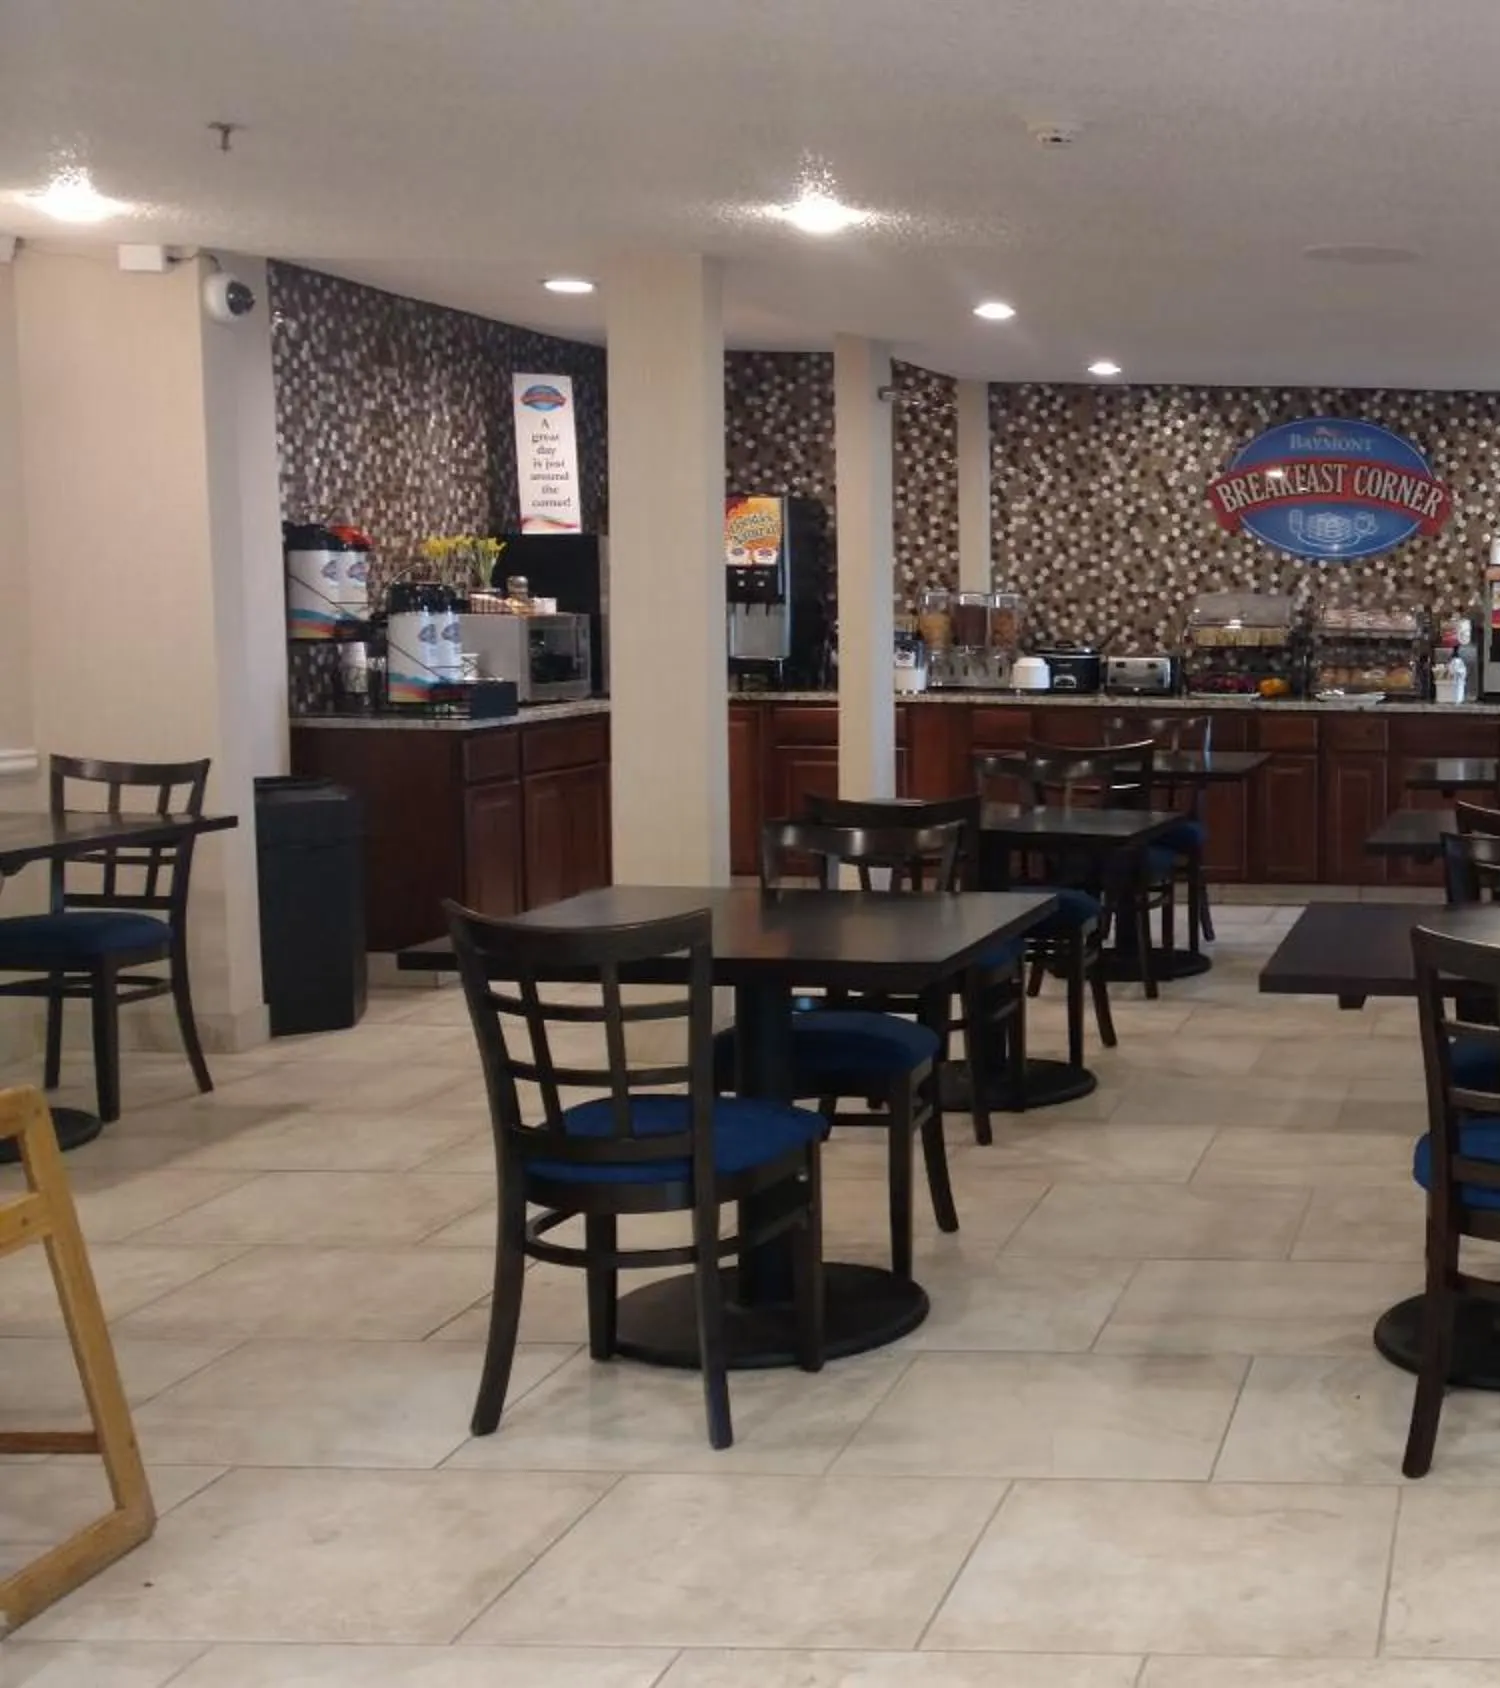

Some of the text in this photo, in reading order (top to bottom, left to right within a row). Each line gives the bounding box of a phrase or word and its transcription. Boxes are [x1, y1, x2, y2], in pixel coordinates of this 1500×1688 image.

[541, 417, 550, 429] A
[1215, 463, 1443, 518] BREAKFAST CORNER
